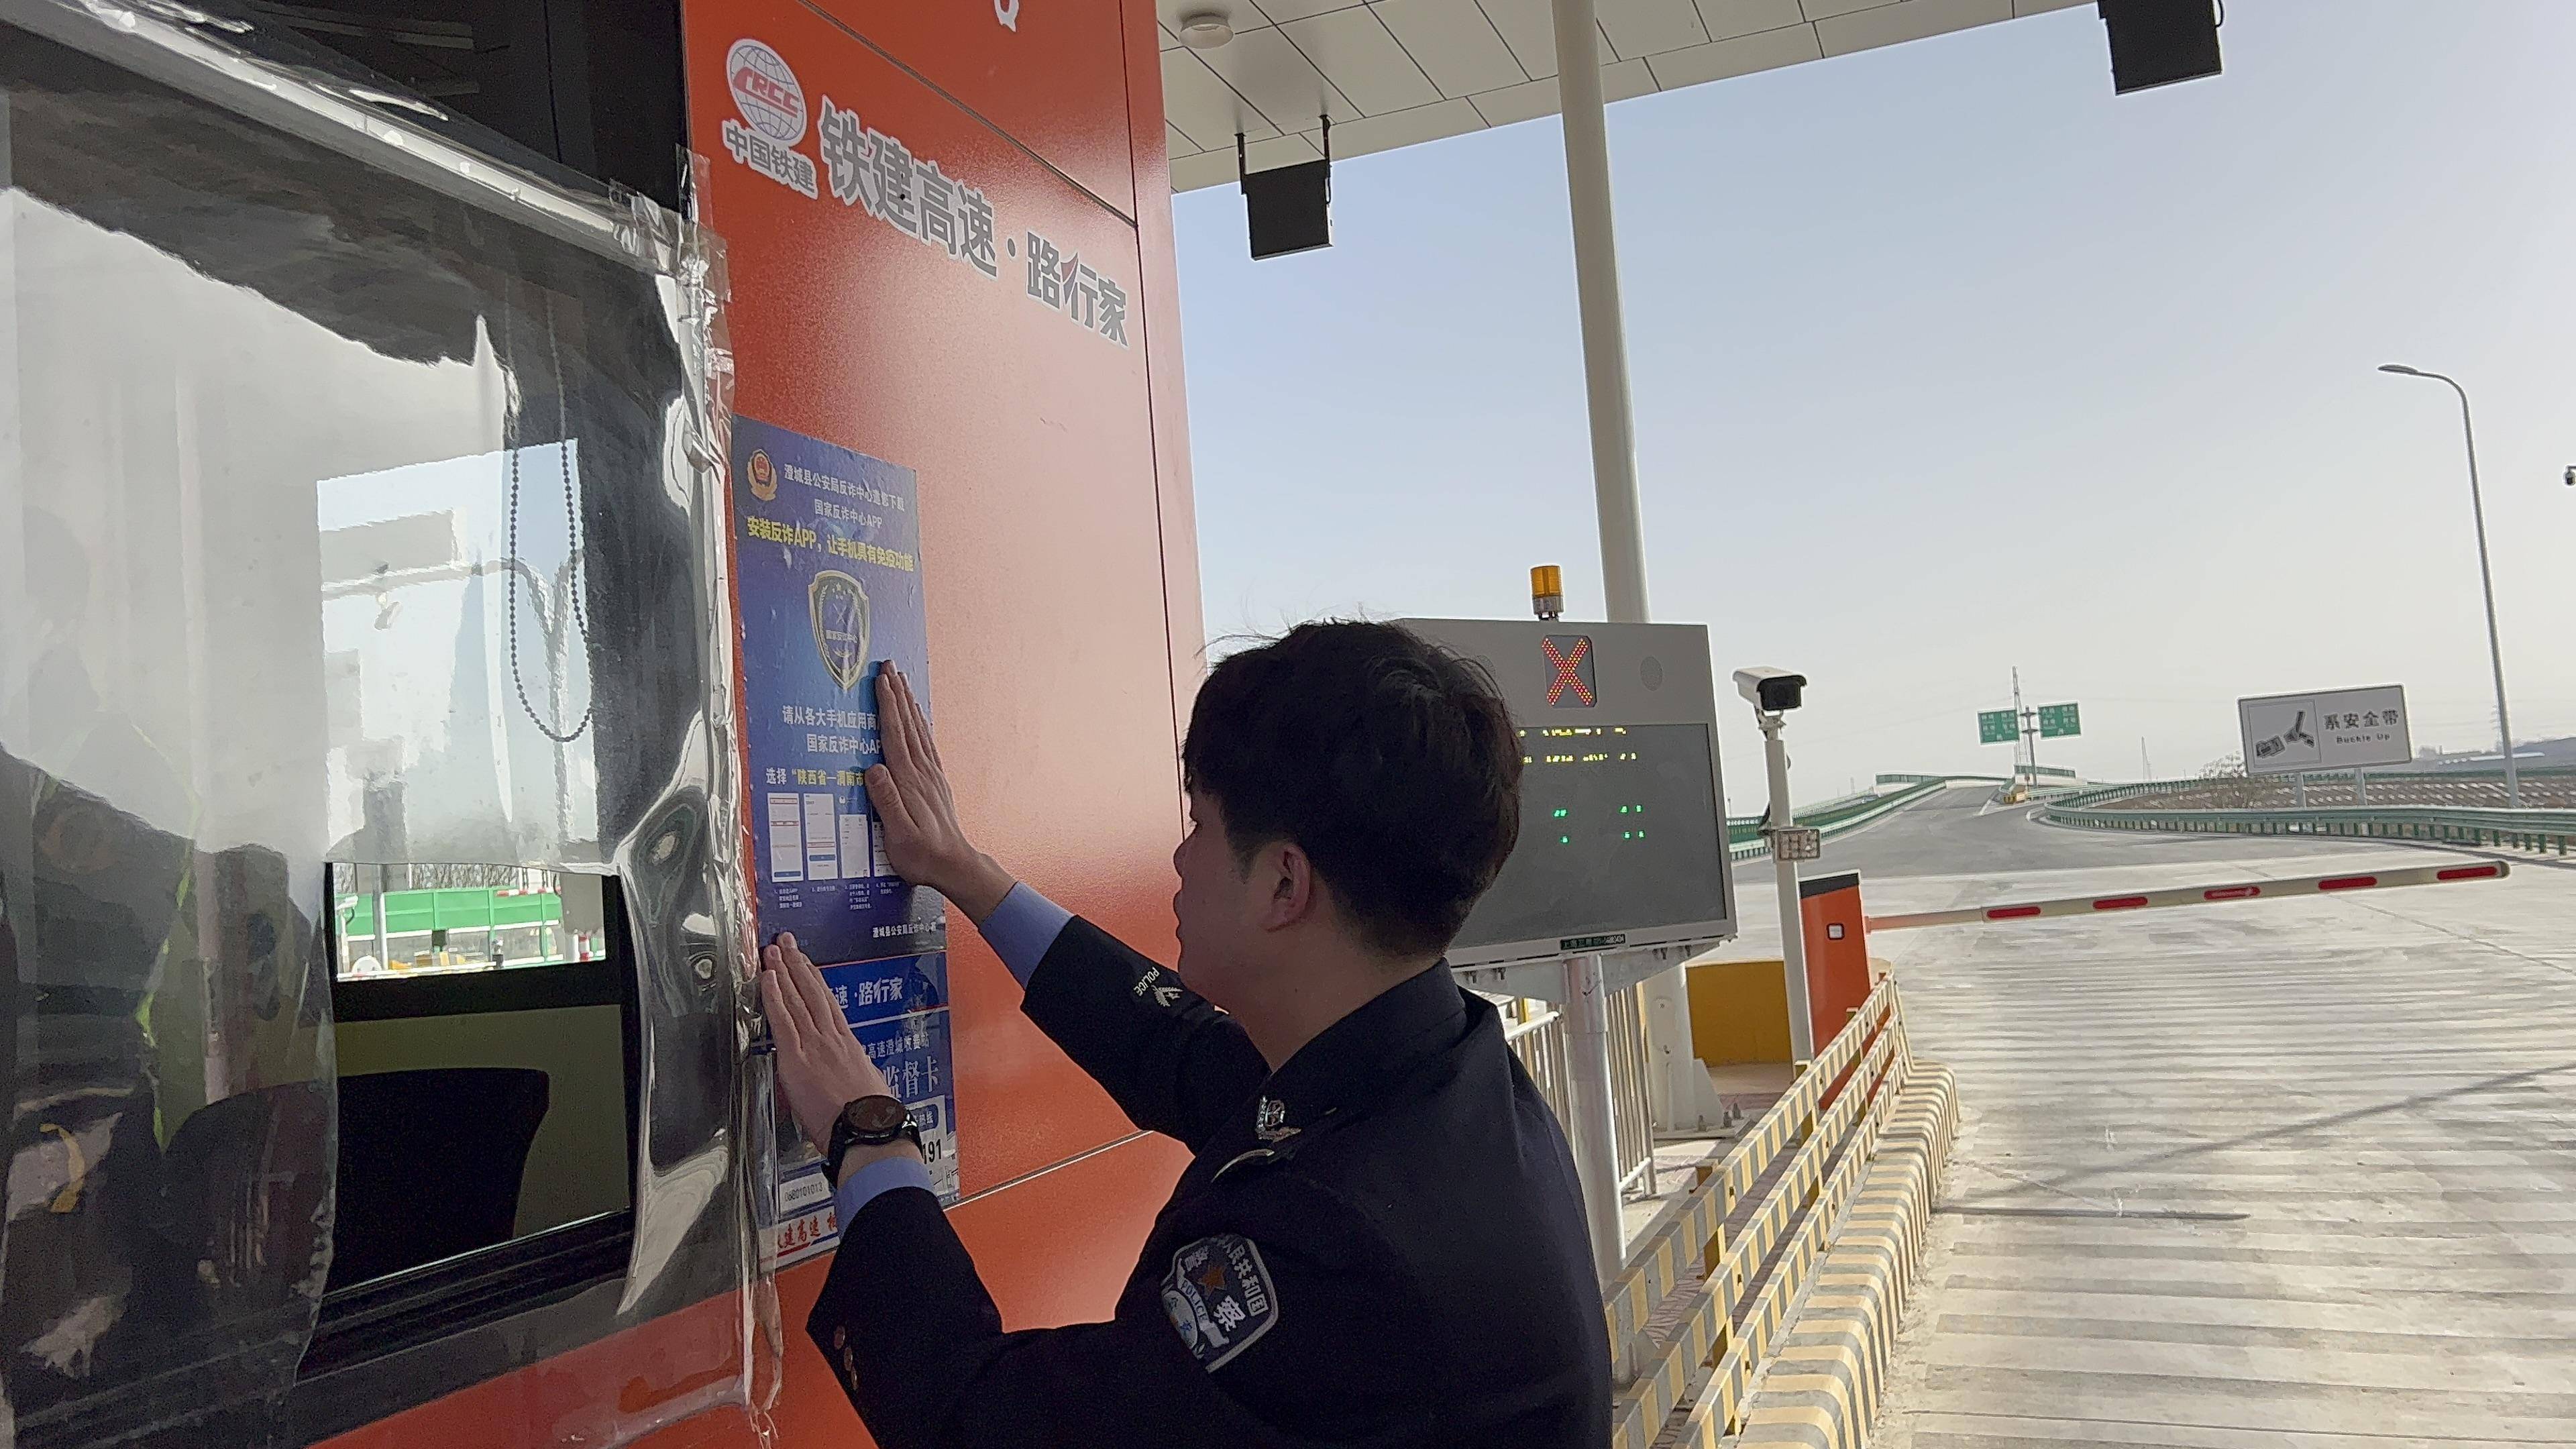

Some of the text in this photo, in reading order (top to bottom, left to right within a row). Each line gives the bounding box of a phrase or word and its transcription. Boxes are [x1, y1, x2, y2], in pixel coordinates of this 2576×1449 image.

[733, 66, 799, 118] CRCC
[724, 124, 816, 195] 中国铁建
[814, 498, 883, 529] 国家反诈中心APP
[782, 704, 879, 731] 请从各大手机应用商
[2323, 709, 2399, 731] 系安全带
[2336, 733, 2390, 744] Buckle Up
[832, 977, 904, 1009] 速·路行家
[1133, 966, 1160, 997] POLICE
[1180, 1279, 1208, 1323] POLICE
